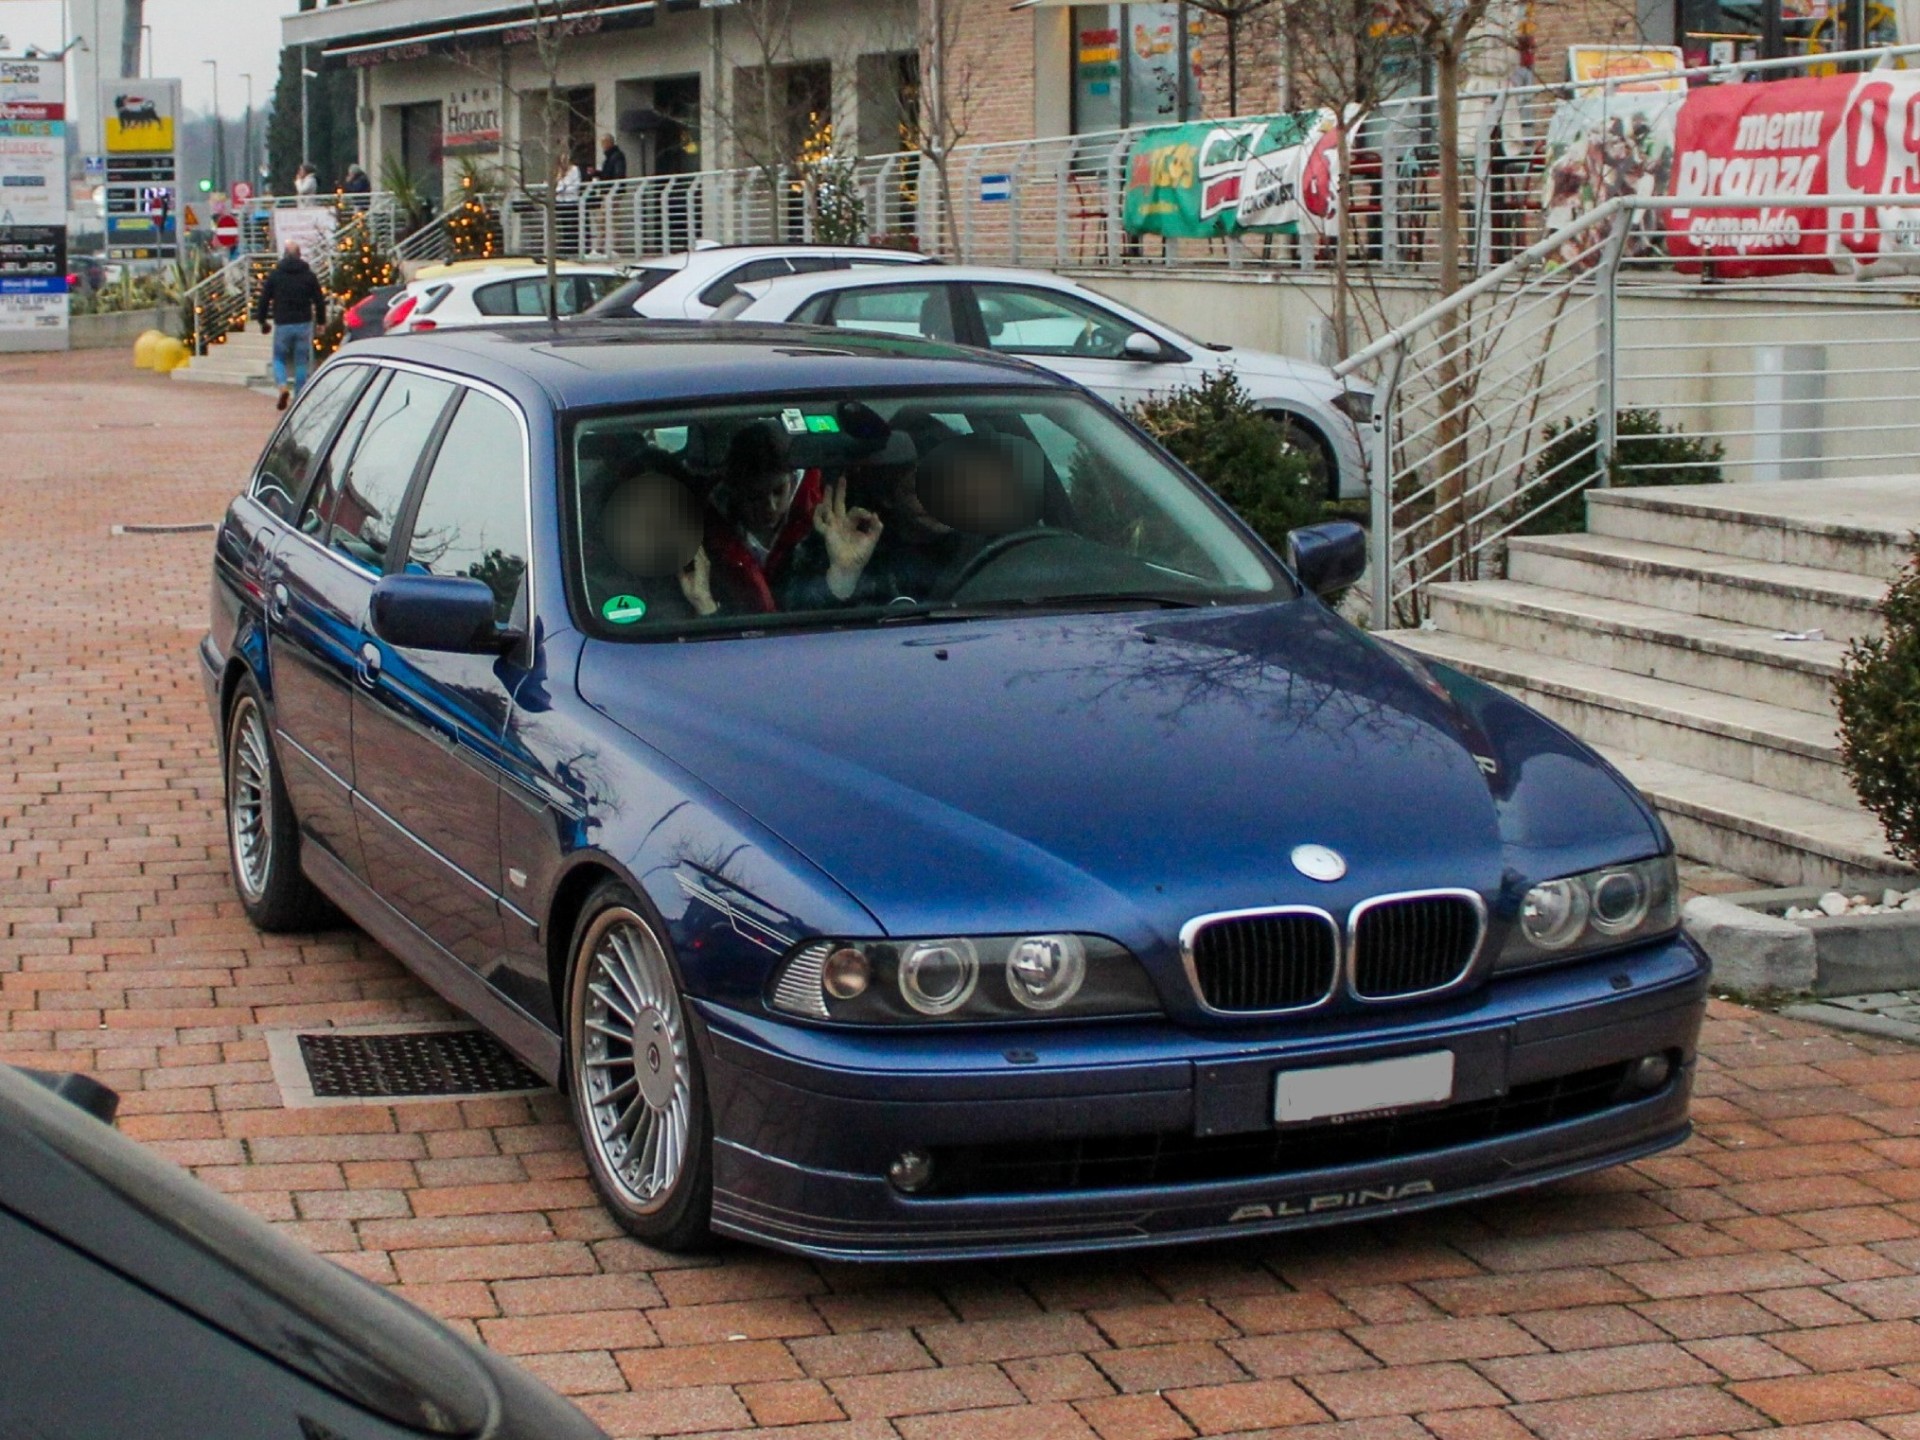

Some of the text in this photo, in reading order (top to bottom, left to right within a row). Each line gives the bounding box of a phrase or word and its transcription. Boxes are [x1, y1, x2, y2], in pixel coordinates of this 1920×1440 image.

[1, 63, 39, 74] Centro
[14, 73, 39, 83] Zeta
[1733, 110, 1824, 150] menu
[1689, 209, 1800, 255] completo
[0, 244, 55, 253] EDLEY
[617, 596, 629, 609] 4
[1228, 1179, 1436, 1222] ALPINA
